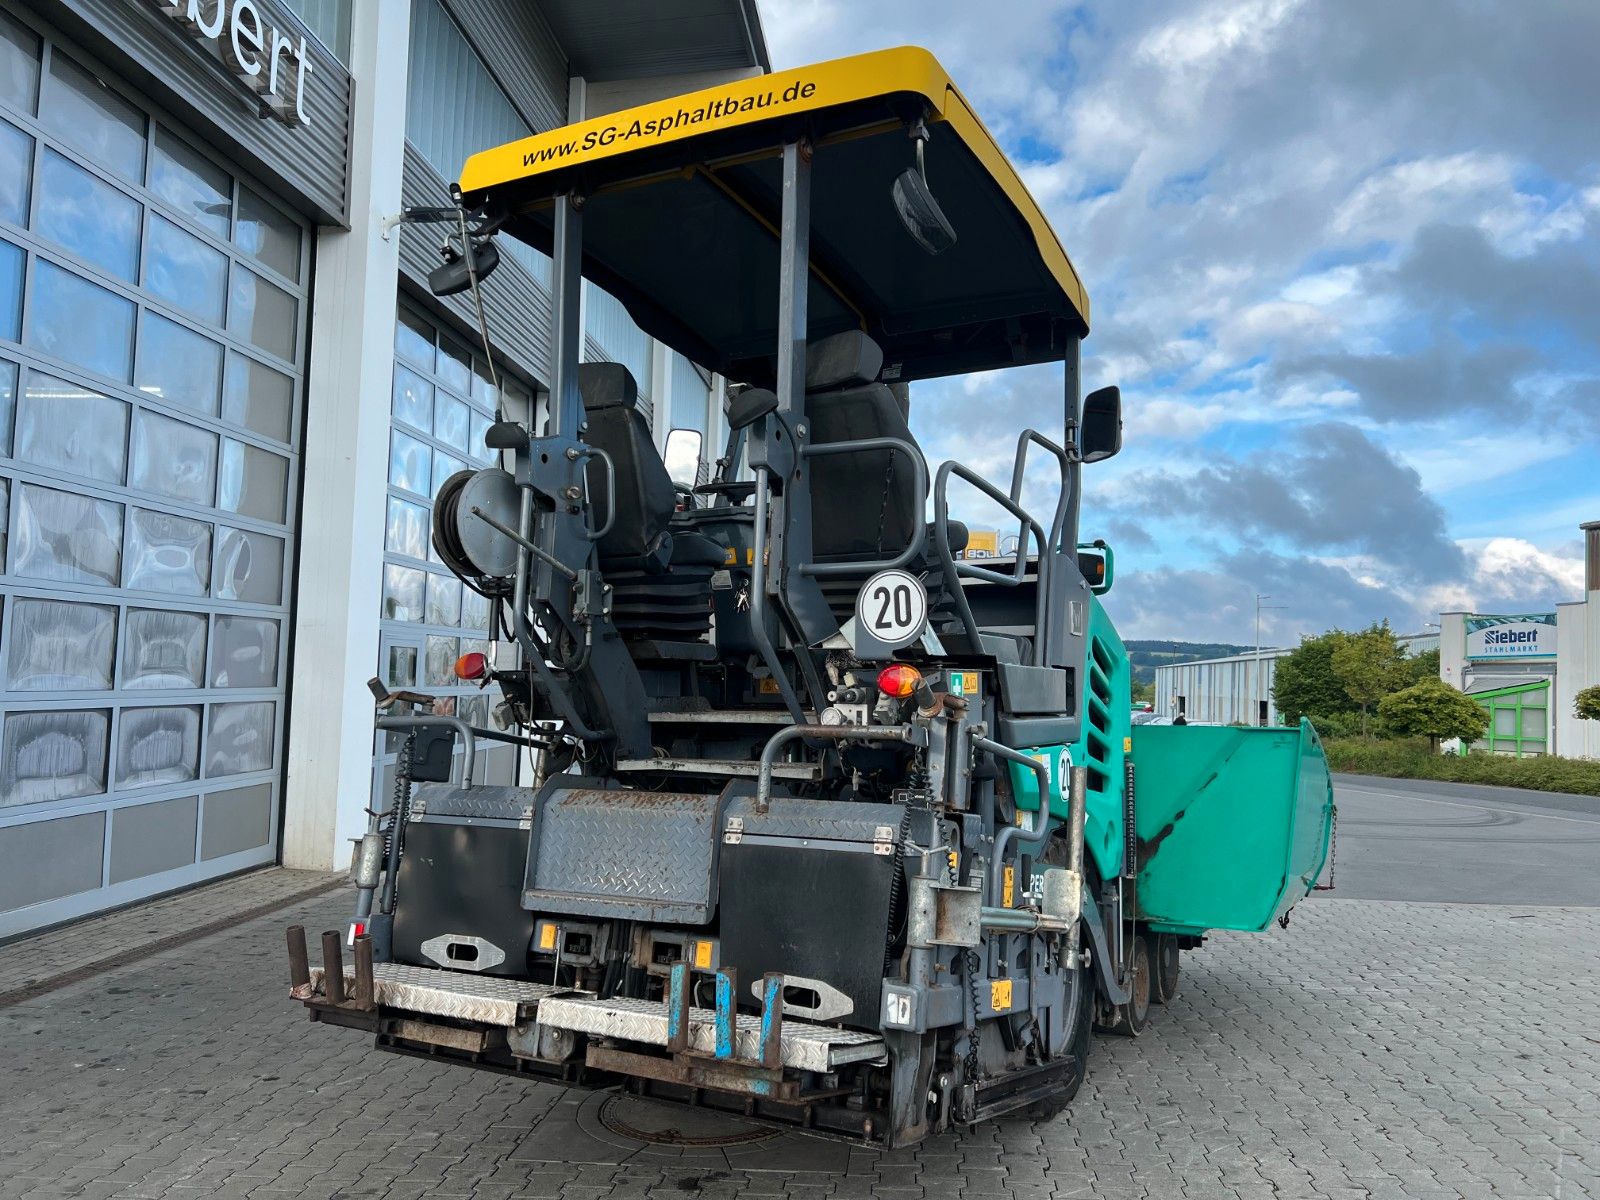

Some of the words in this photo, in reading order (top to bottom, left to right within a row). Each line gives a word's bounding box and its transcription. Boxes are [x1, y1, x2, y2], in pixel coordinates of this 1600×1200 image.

[522, 81, 816, 167] www.SG-Asphaltbau.de
[873, 584, 912, 629] 20
[1484, 629, 1538, 645] Siebert
[1484, 645, 1538, 653] STAHLMARKT
